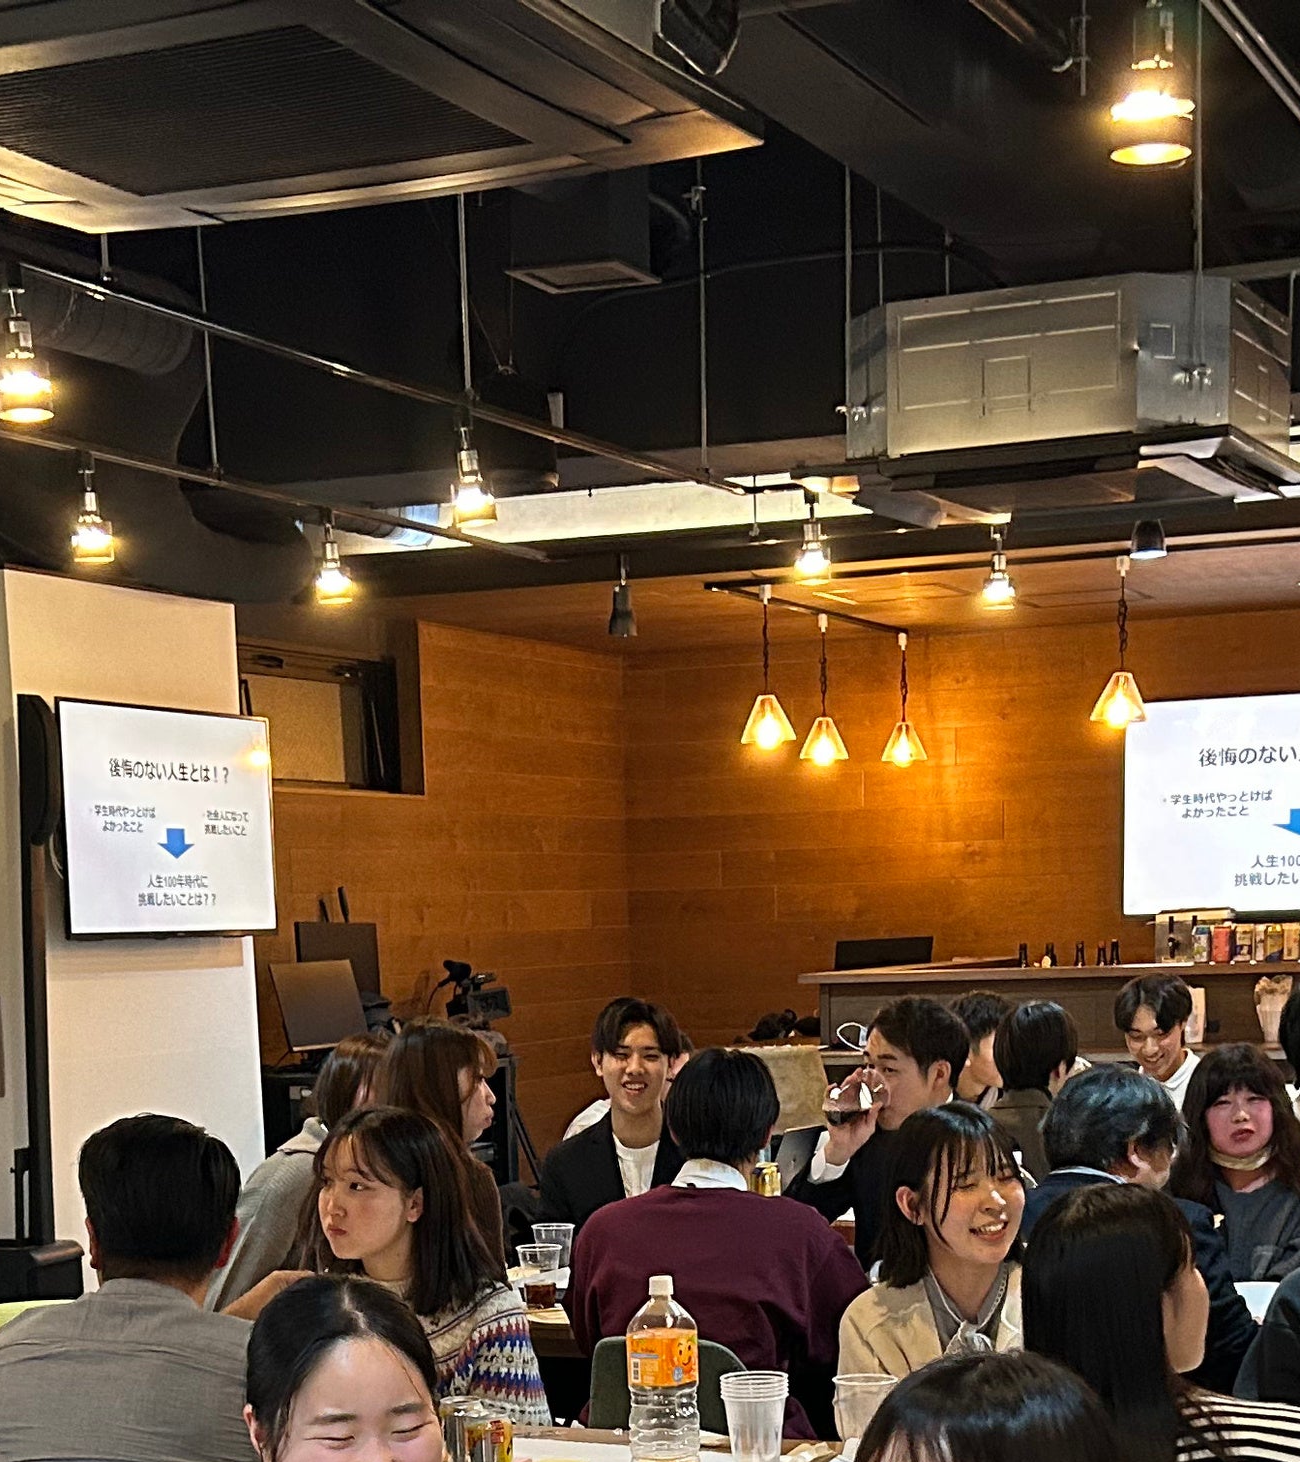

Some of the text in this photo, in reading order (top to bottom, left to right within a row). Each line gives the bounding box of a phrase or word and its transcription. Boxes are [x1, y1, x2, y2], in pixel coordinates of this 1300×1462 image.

[1170, 789, 1273, 805] 学生時代やっとけば
[1181, 804, 1250, 819] よかったこと
